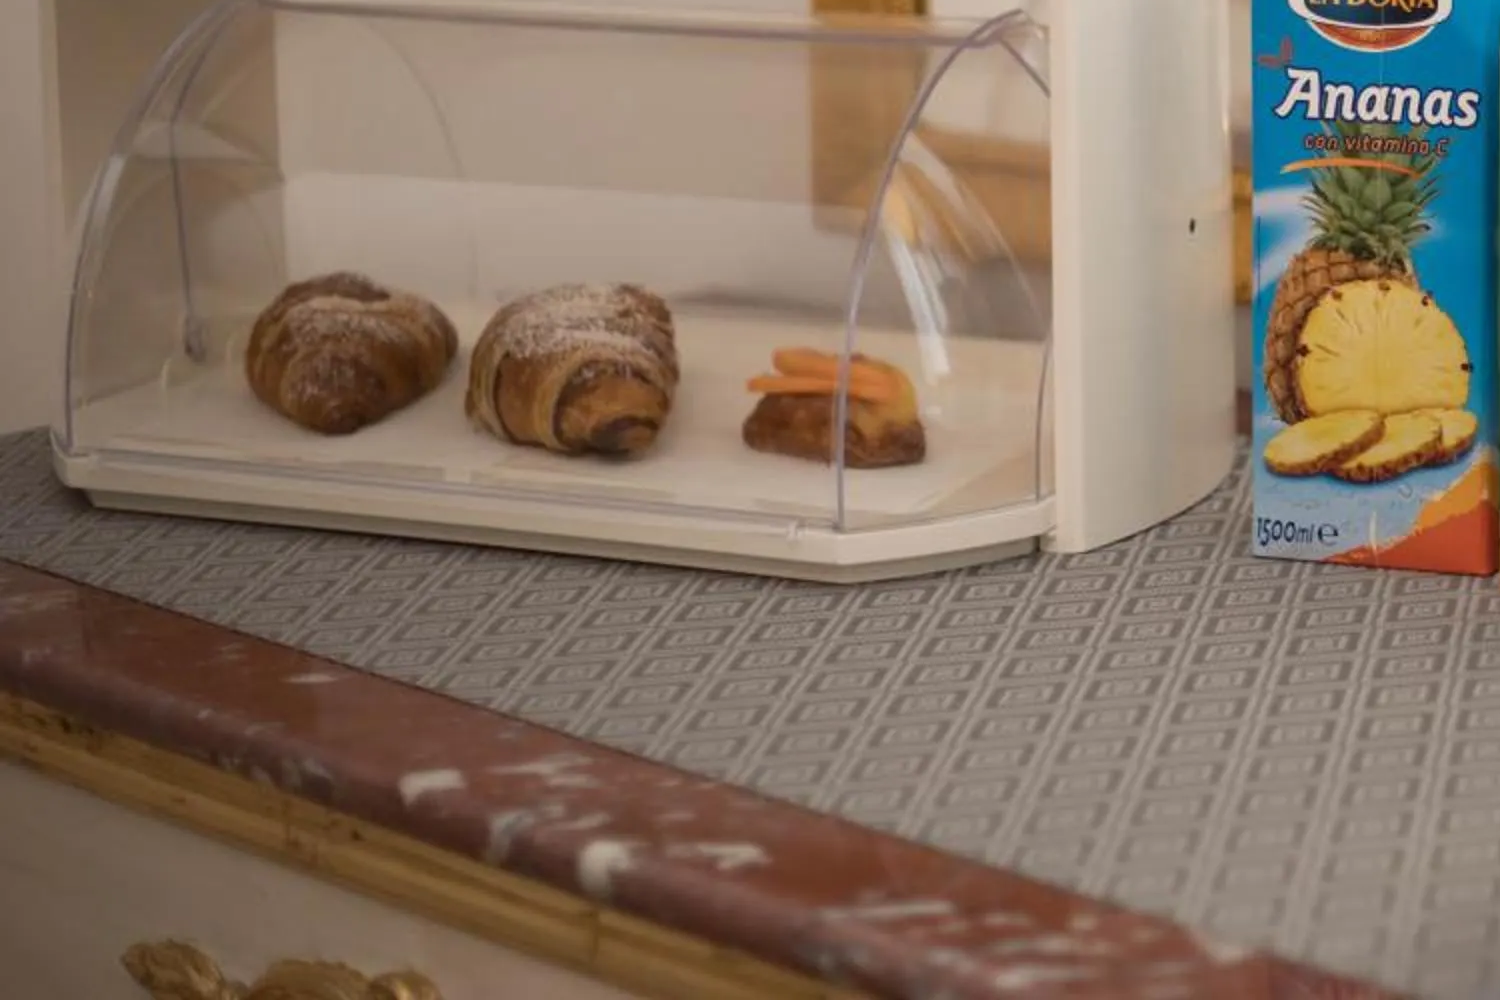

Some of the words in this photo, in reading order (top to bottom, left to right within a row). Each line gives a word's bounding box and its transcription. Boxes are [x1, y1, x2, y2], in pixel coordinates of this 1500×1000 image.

[1275, 66, 1480, 128] Ananas
[1304, 135, 1338, 150] con
[1345, 135, 1430, 155] vitamina
